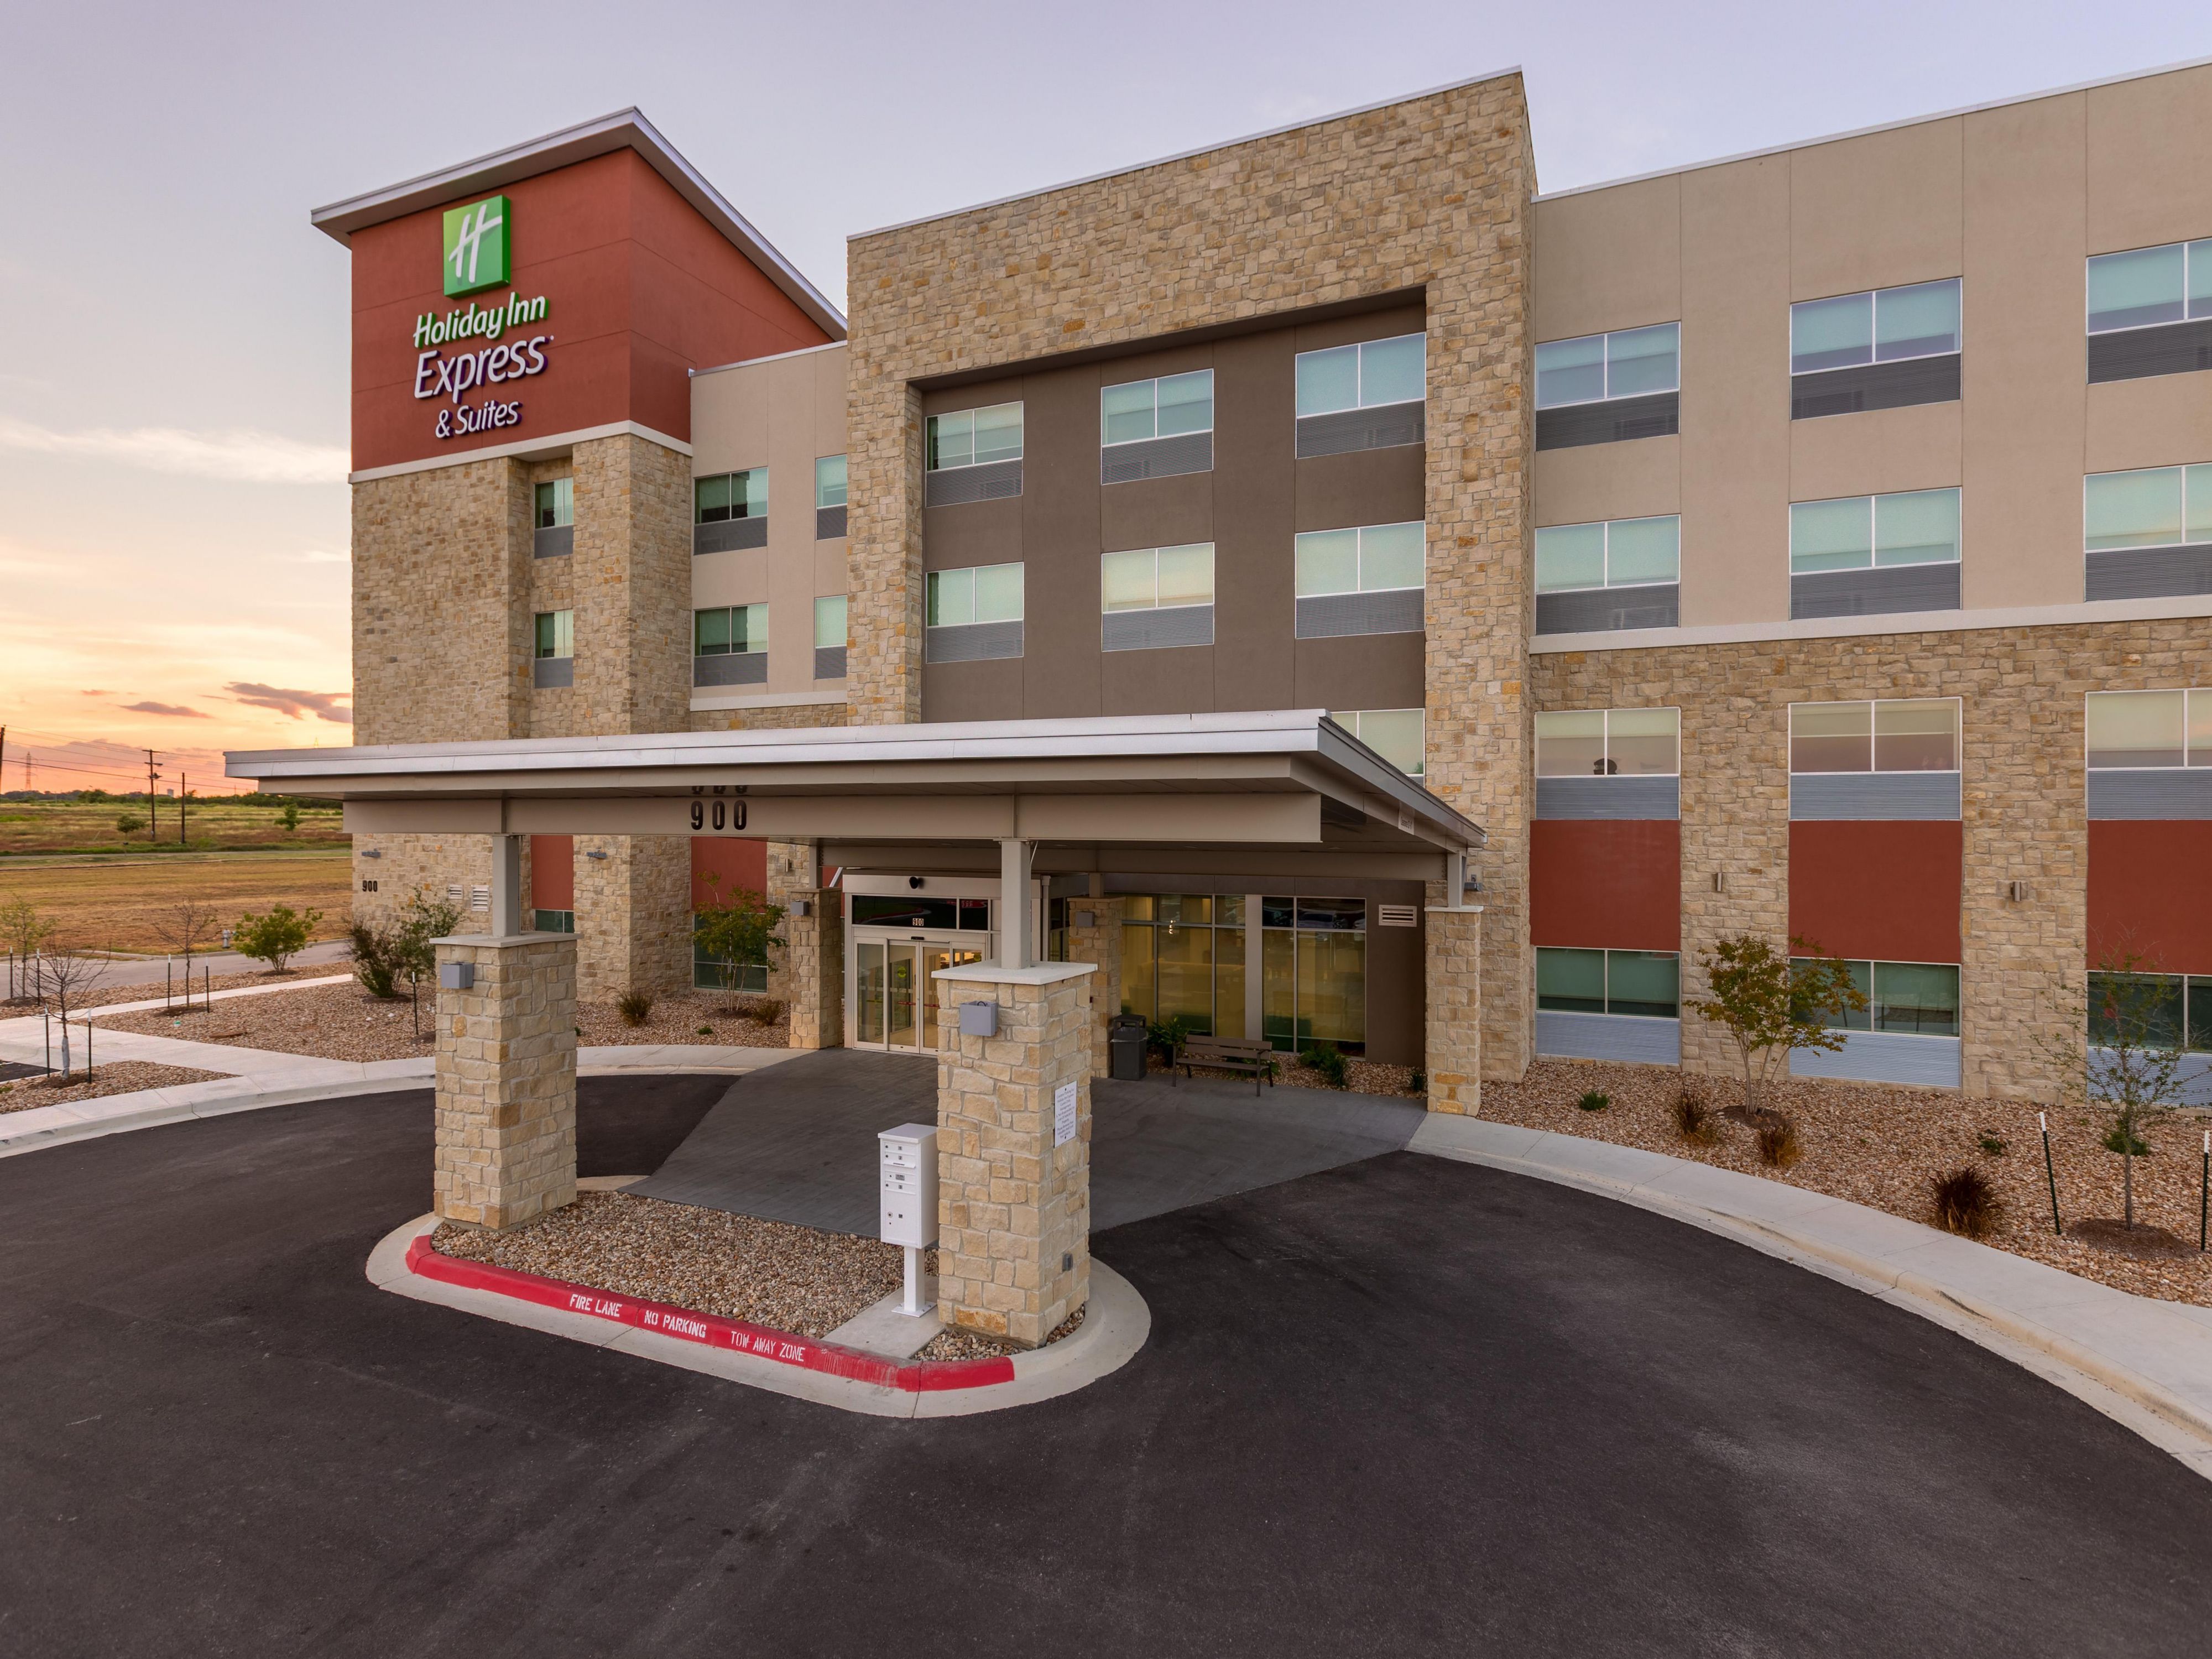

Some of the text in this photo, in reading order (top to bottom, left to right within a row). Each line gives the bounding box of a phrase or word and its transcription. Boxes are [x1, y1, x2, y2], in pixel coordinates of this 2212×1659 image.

[413, 291, 546, 349] Holiday Inn
[414, 336, 546, 404] Express
[435, 400, 520, 438] & Suites
[691, 800, 747, 831] 900
[362, 880, 378, 892] 900
[570, 1293, 623, 1317] FIRE LANE
[644, 1310, 707, 1338] NO PARKING
[753, 1337, 776, 1355] AWAY
[779, 1343, 806, 1362] ZONE
